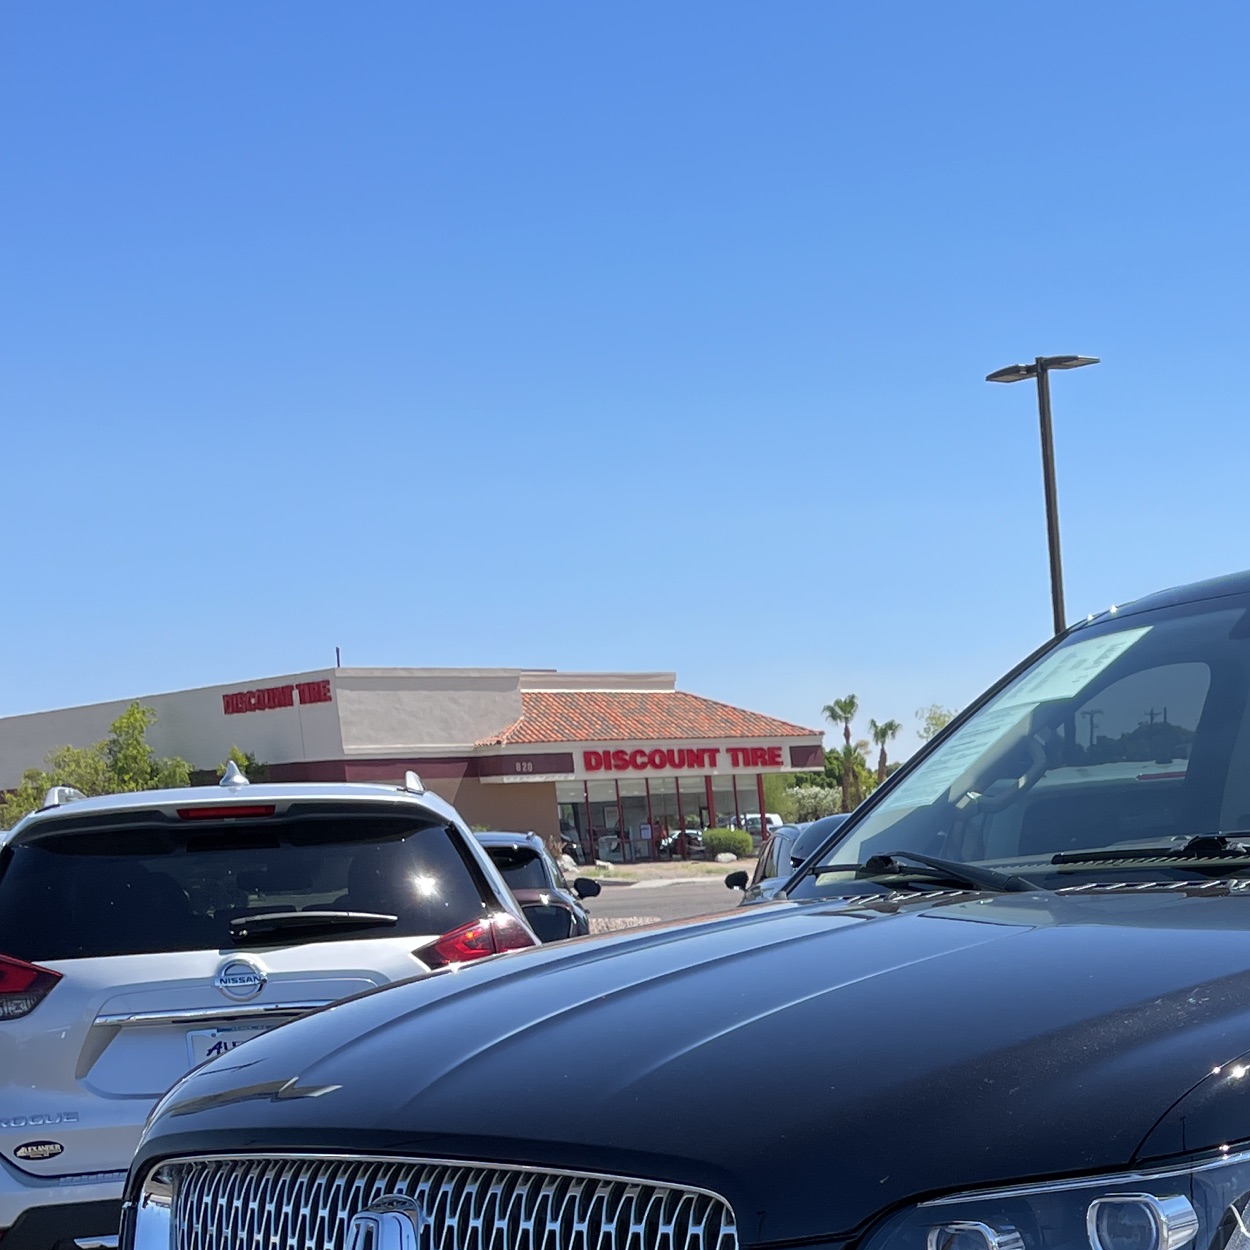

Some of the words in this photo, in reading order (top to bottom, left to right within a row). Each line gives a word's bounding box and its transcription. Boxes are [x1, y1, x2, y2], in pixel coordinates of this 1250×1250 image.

[222, 685, 294, 715] DISCOUNT
[295, 679, 332, 705] TIRE
[583, 748, 720, 772] DISCOUNT
[726, 746, 784, 768] TIRE
[219, 975, 262, 985] NISSAN
